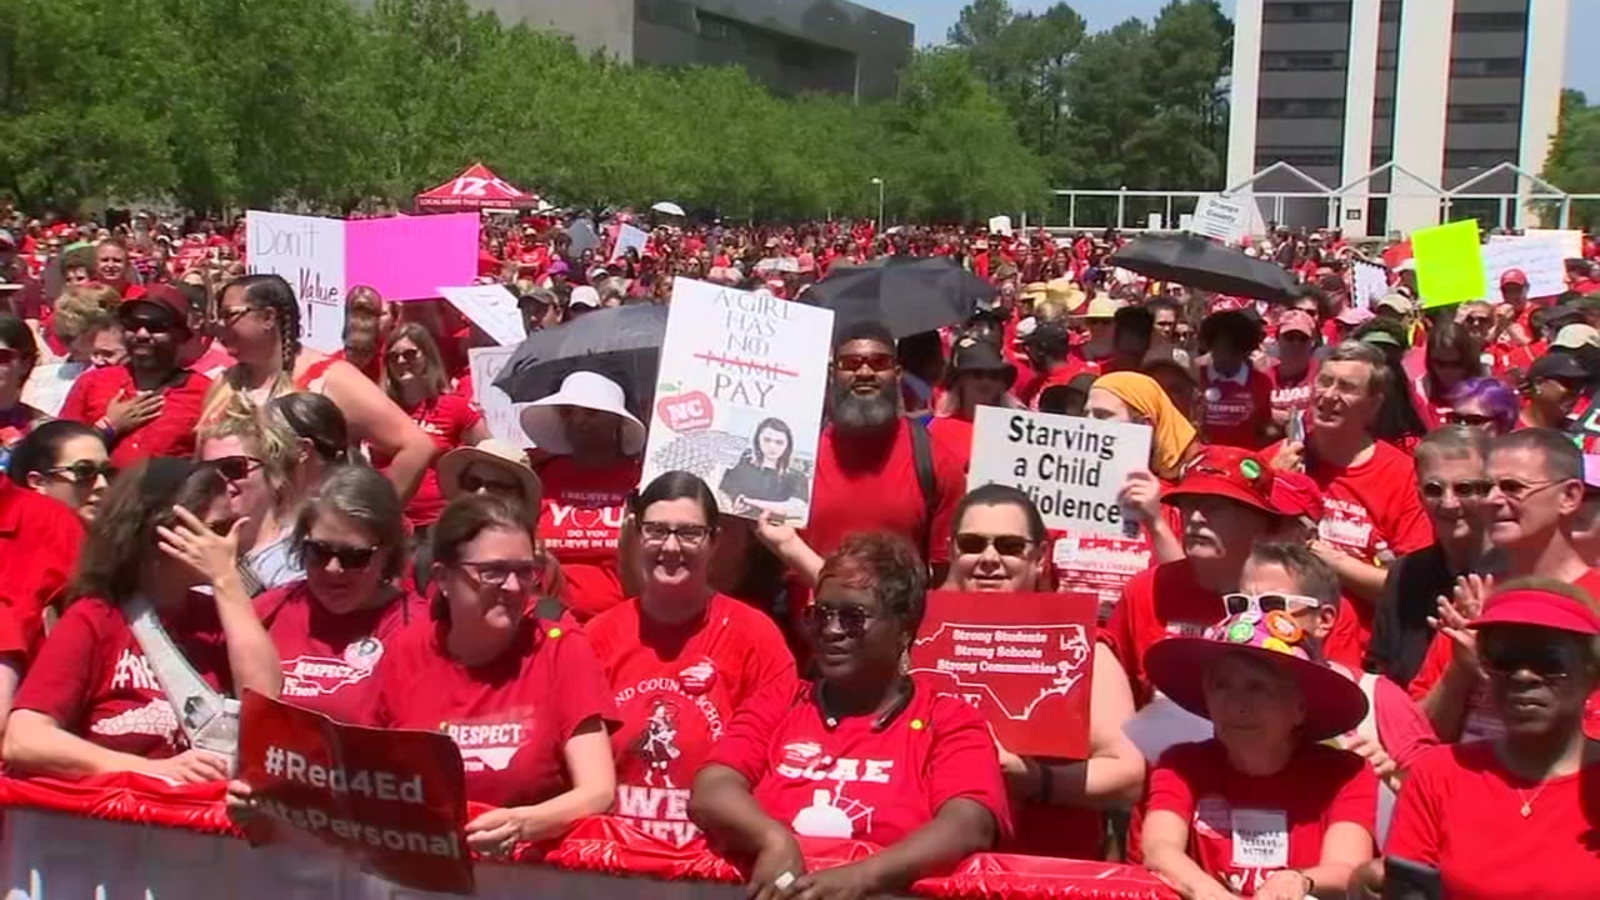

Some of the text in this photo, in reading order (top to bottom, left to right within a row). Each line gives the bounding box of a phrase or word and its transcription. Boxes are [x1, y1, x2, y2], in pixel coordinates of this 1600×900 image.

[419, 198, 511, 208] LOCAL NEWS THAT MATTERS
[256, 220, 320, 258] Don't
[299, 267, 339, 302] Value
[713, 289, 791, 321] A GIRL
[726, 310, 777, 337] HAS
[727, 333, 770, 356] NO
[713, 373, 775, 409] PAY
[666, 400, 704, 421] NC
[1008, 415, 1117, 460] Starving
[1014, 454, 1102, 487] a Child
[566, 492, 608, 501] BELIEVE
[545, 539, 590, 548] BELIEVE
[591, 539, 603, 548] IN
[567, 530, 609, 538] DO YOU
[952, 629, 1048, 644] Strong Students
[954, 645, 1043, 659] Strong Schools
[937, 659, 1057, 675] Strong Communities
[448, 723, 523, 746] RESPECT
[264, 745, 426, 804] #Red4Ed
[617, 784, 691, 821] WE
